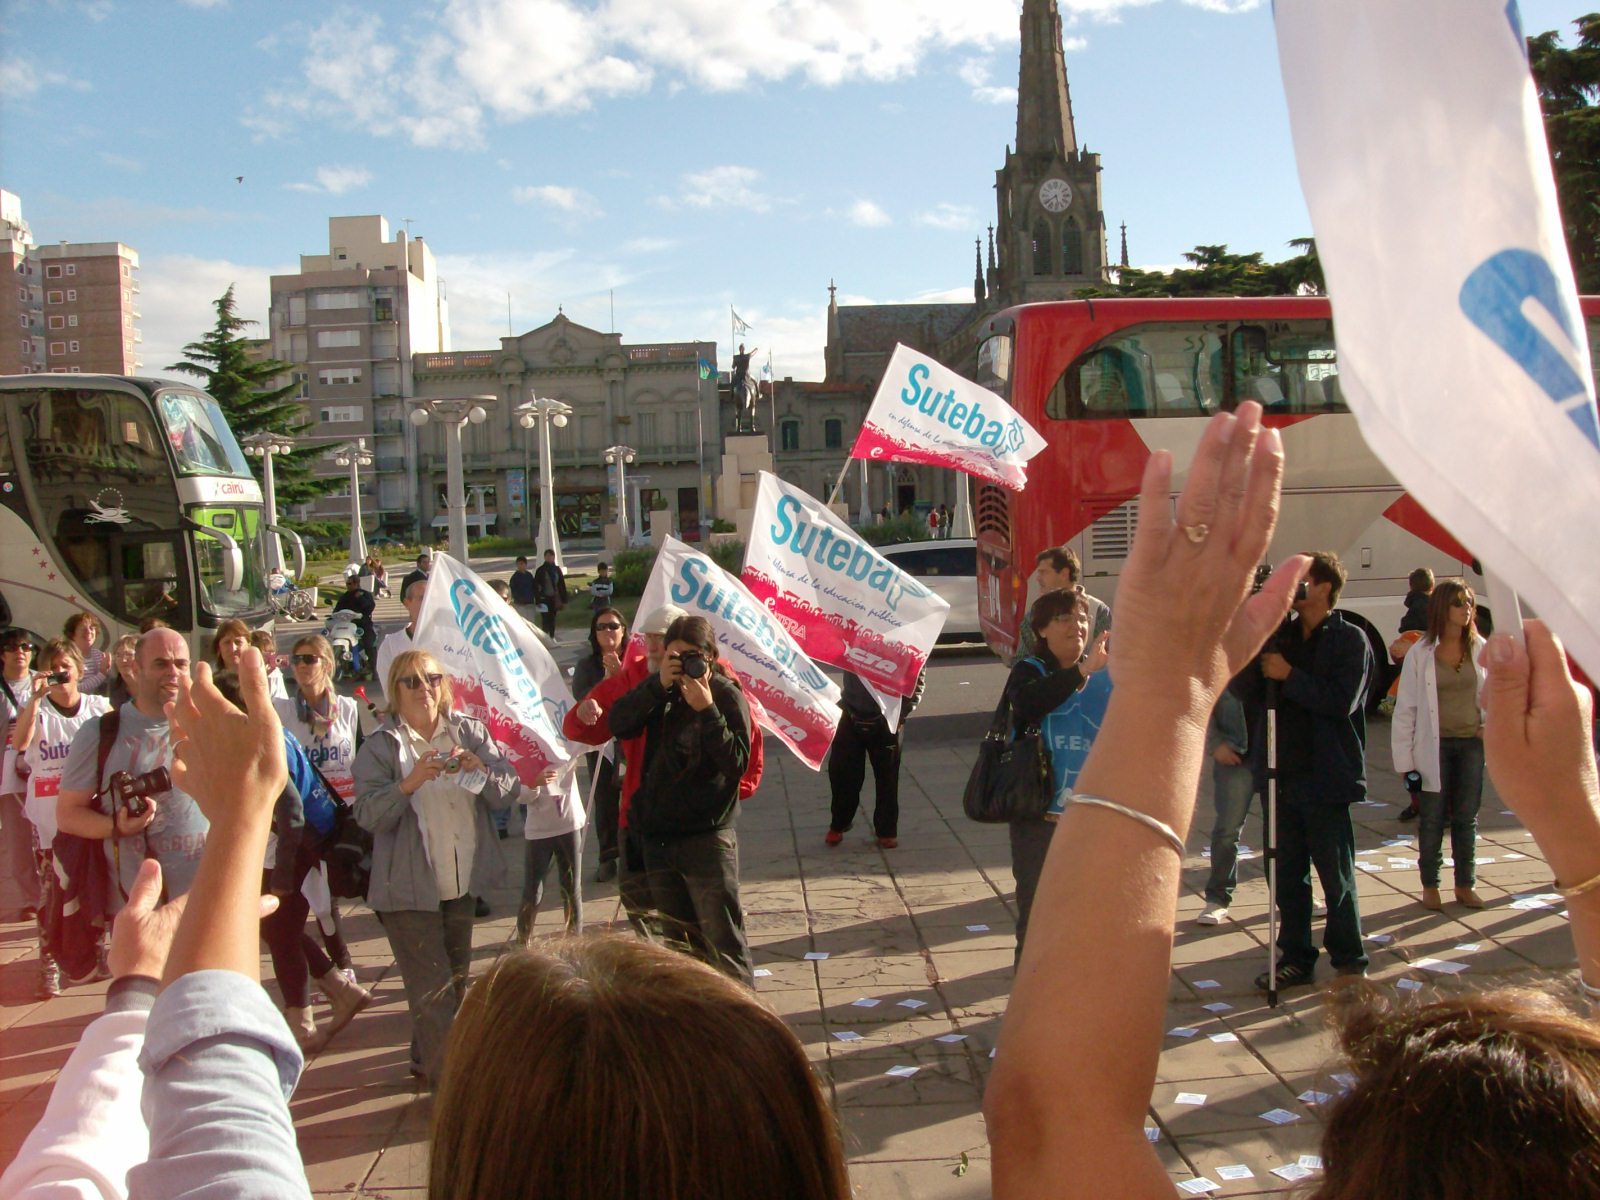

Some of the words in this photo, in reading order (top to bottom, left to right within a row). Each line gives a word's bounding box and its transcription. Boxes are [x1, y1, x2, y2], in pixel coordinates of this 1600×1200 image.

[901, 363, 1003, 447] Suteba
[770, 494, 894, 593] Suteba
[671, 557, 791, 665] Suteba
[811, 577, 821, 590] la
[823, 586, 866, 611] educación
[867, 608, 902, 627] pública
[718, 632, 729, 645] la
[731, 642, 778, 672] educación
